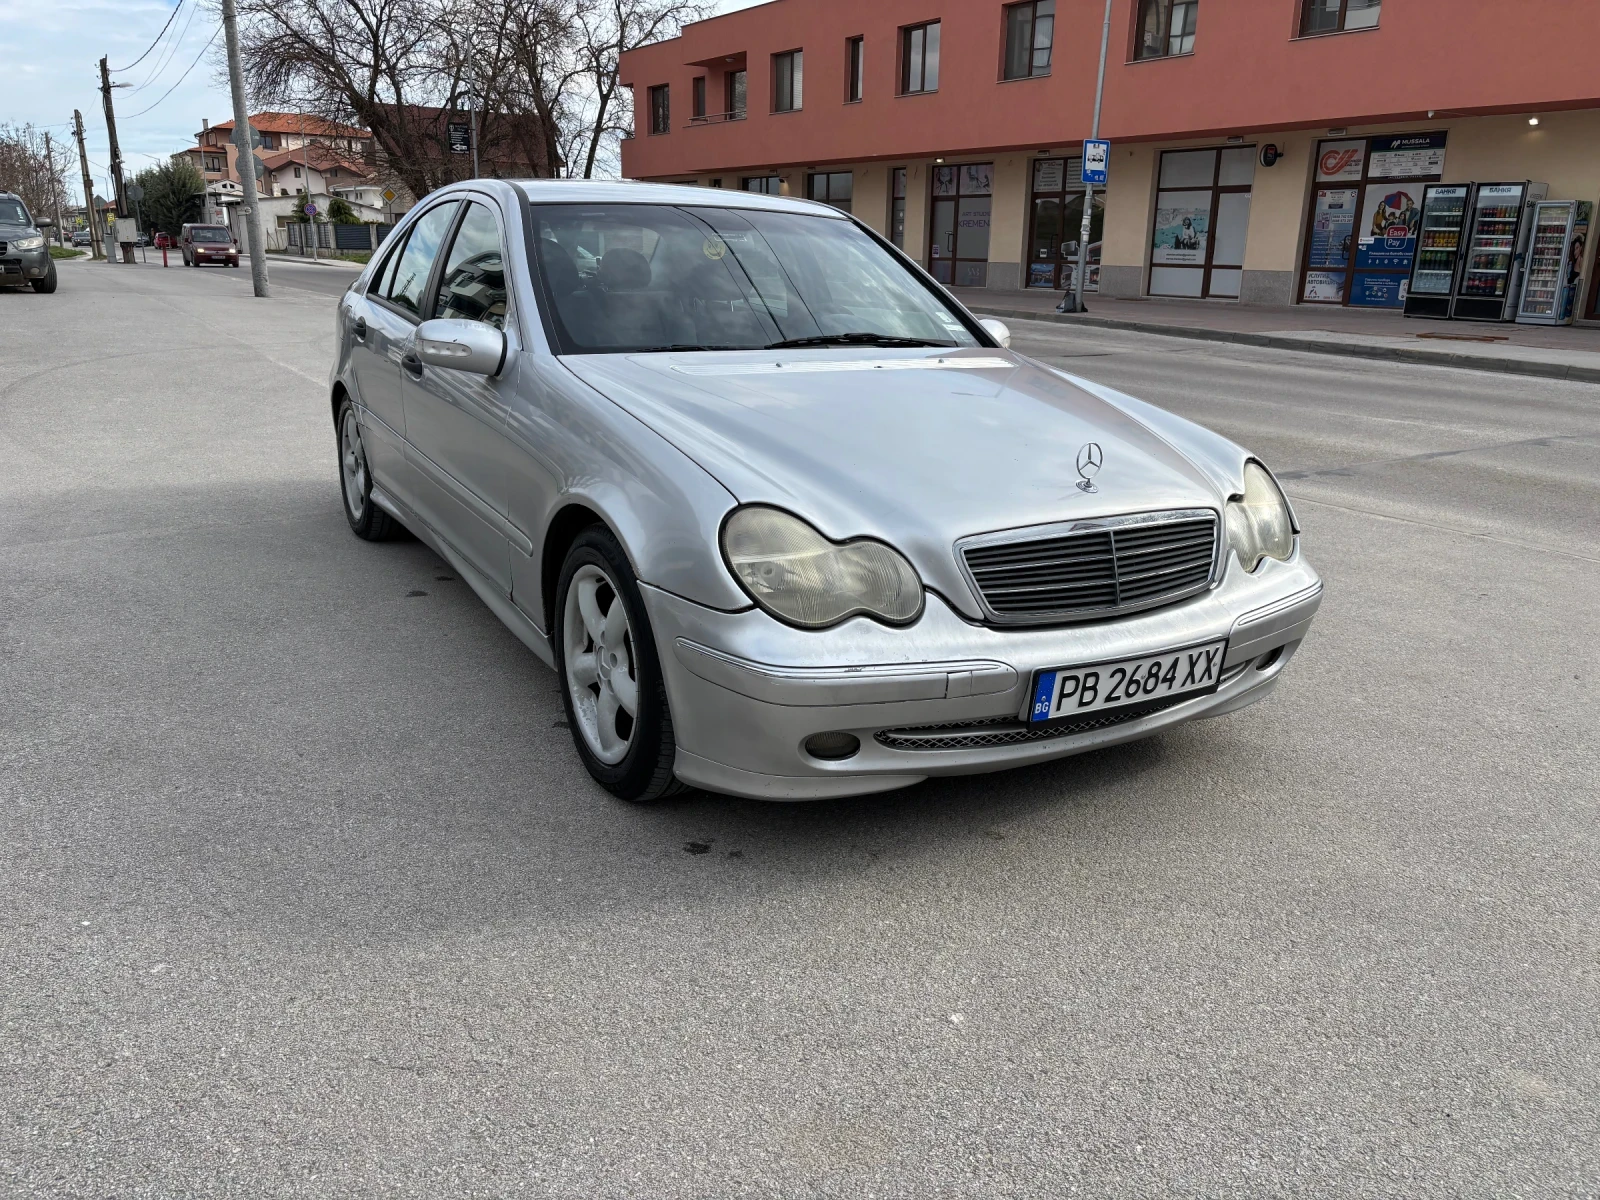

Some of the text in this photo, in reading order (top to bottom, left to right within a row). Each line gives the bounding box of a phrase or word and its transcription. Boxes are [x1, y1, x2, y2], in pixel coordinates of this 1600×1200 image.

[1389, 229, 1406, 238] Easy
[1387, 239, 1401, 248] Pay
[1055, 647, 1220, 712] PB 2684 XX
[1034, 702, 1049, 714] BG
